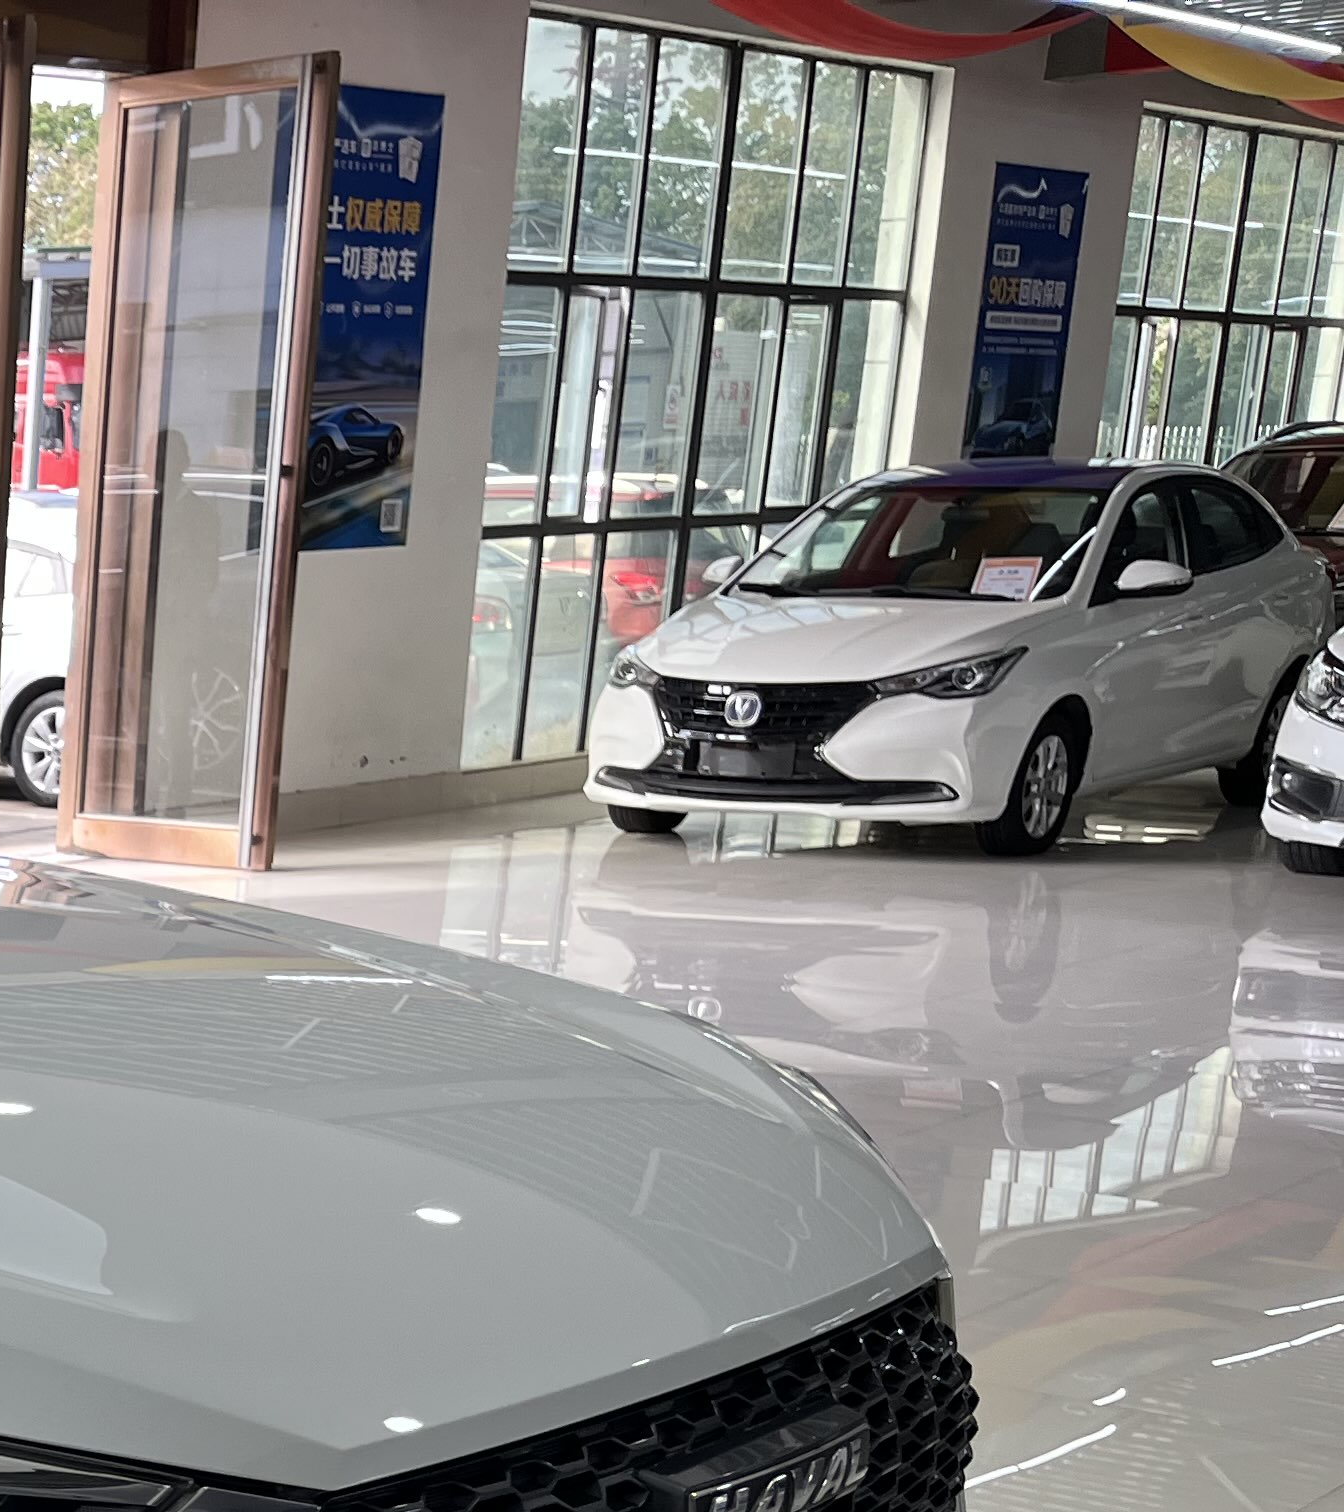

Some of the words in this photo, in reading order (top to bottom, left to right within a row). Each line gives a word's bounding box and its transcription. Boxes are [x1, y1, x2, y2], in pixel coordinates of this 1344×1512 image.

[323, 244, 417, 283] 一切事故车
